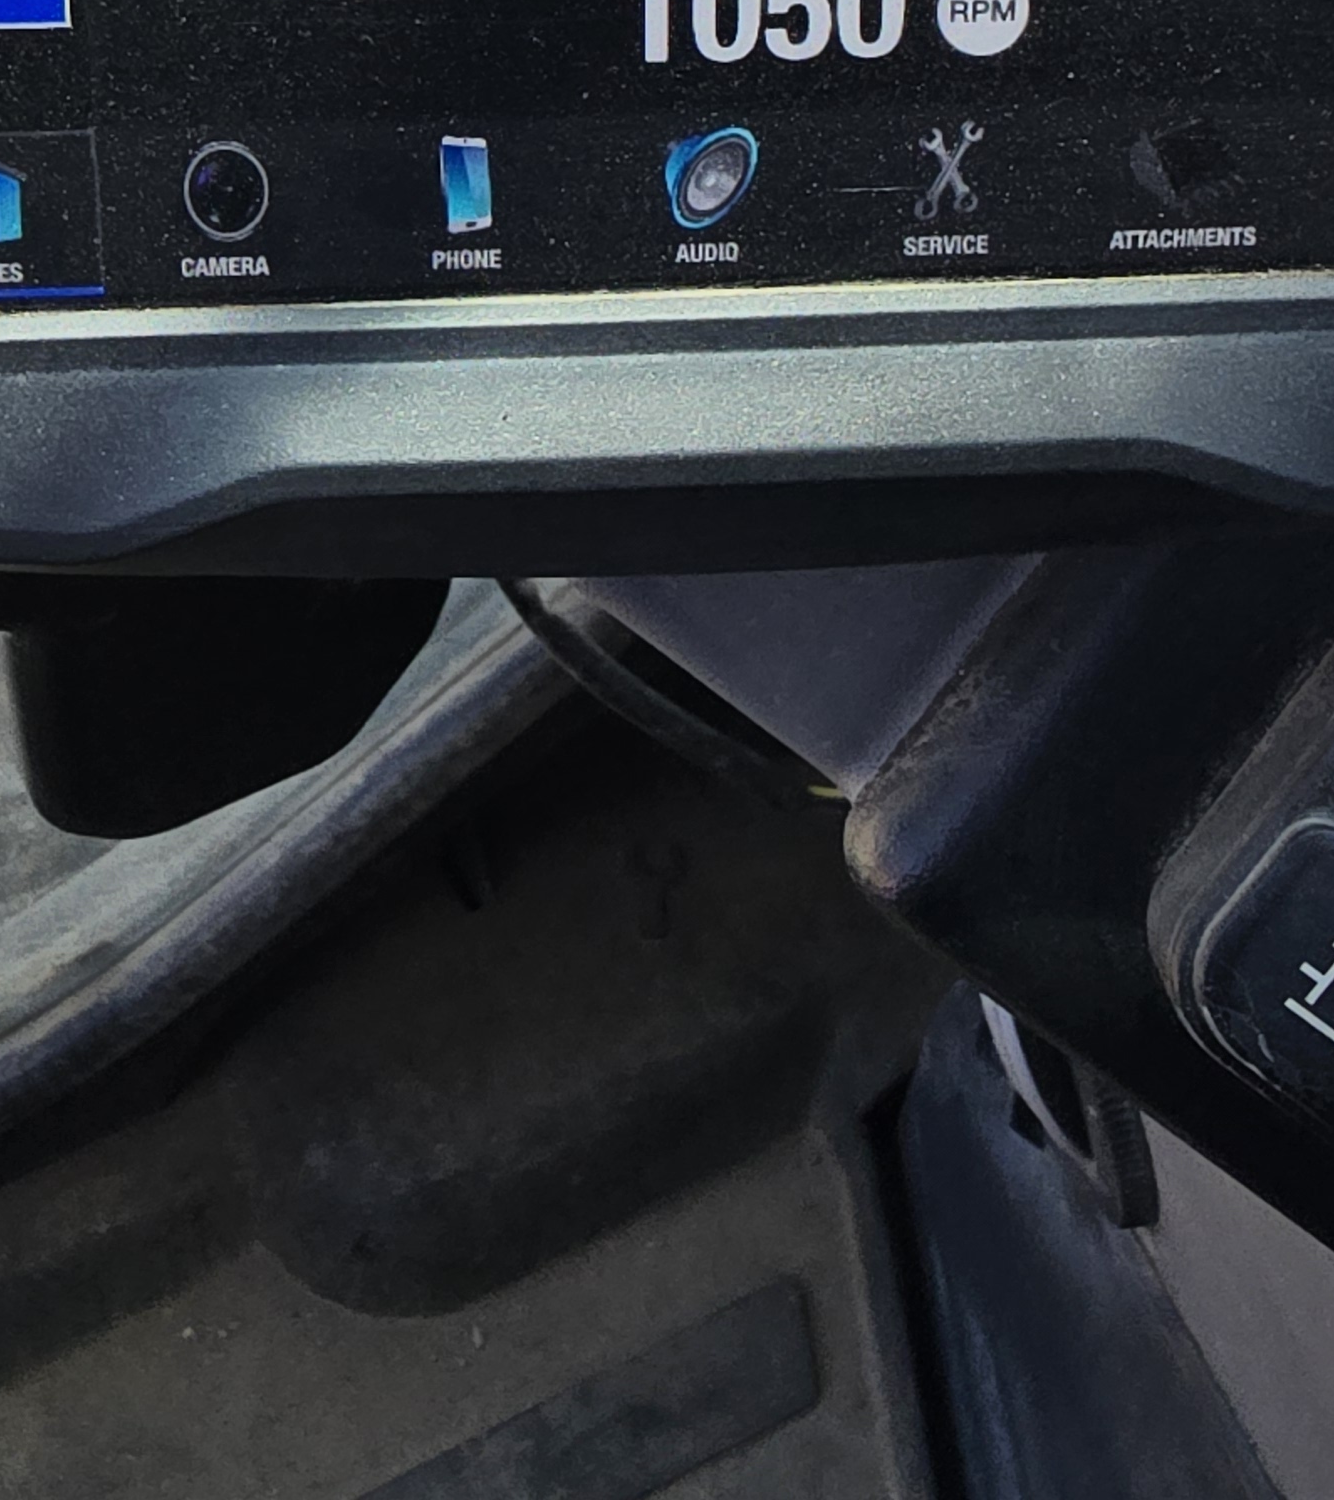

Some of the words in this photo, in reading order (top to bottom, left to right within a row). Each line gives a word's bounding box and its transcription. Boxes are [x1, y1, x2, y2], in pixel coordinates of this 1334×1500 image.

[902, 234, 990, 257] SERVICE
[1108, 226, 1257, 251] ATTACHMENTS
[430, 247, 504, 271] PHONE
[674, 242, 740, 264] AUDIO
[180, 255, 271, 279] CAMERA
